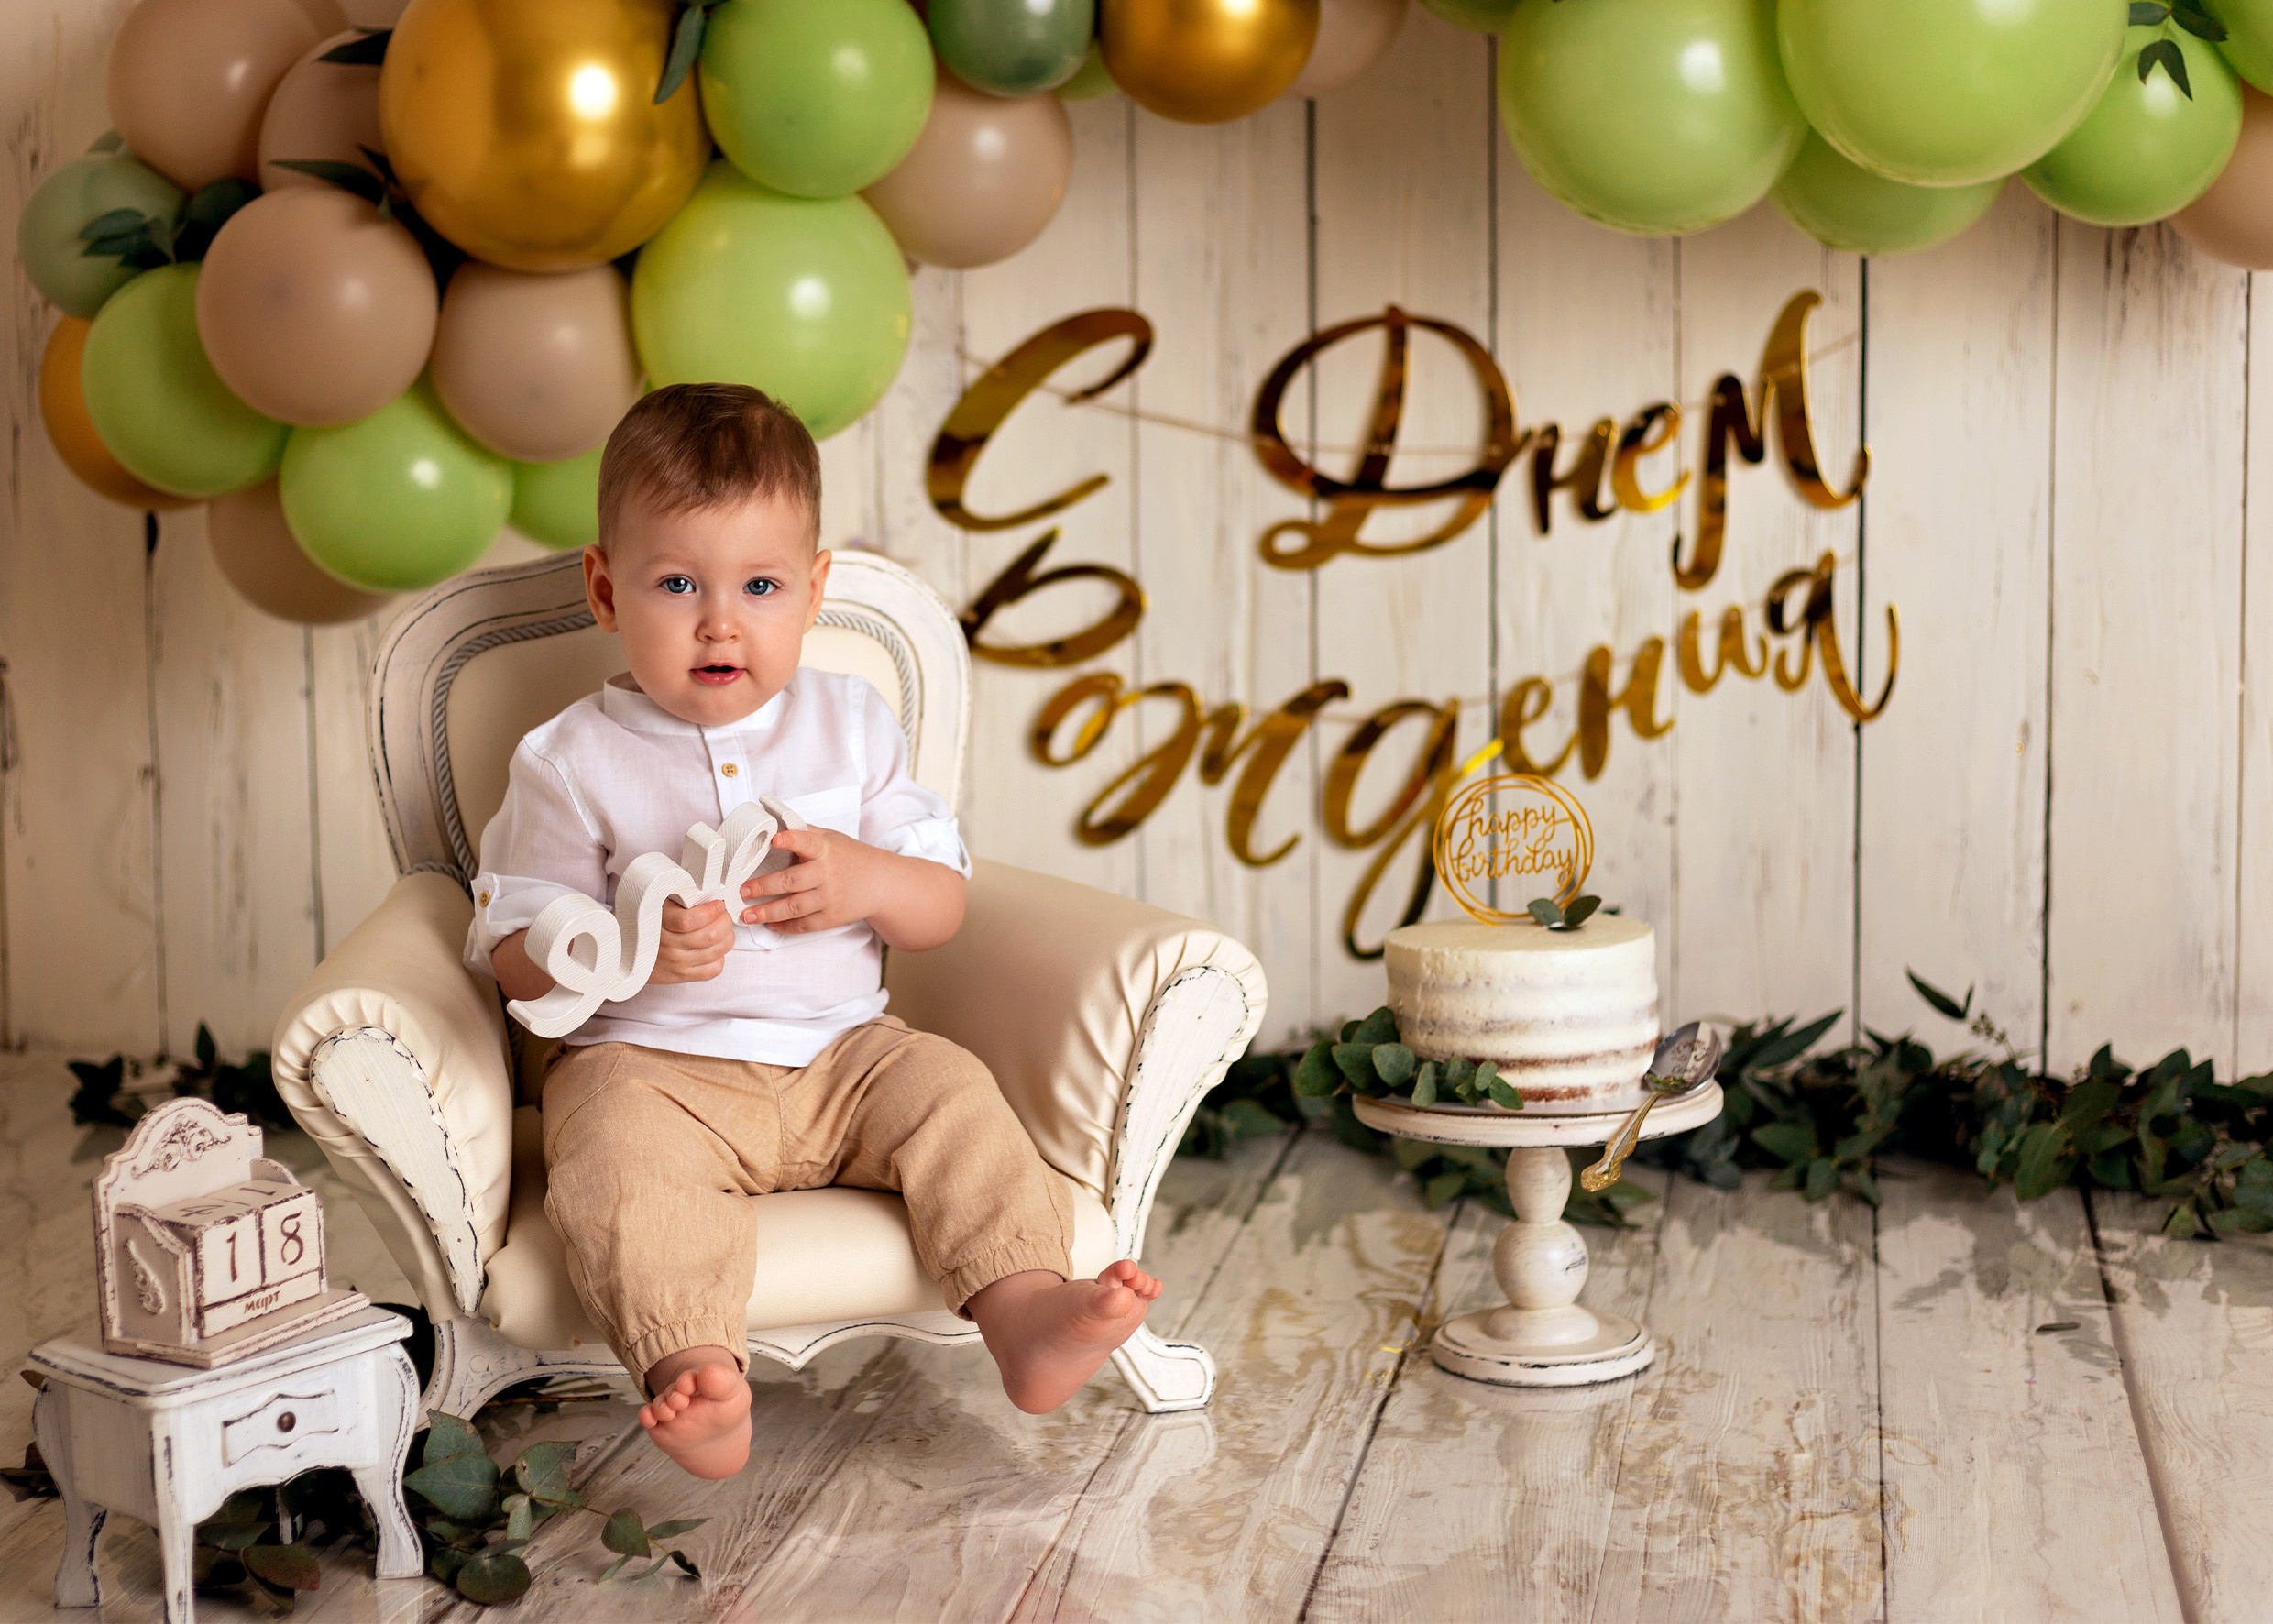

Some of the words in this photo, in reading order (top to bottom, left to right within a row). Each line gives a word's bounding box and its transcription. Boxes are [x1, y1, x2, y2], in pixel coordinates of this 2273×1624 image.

[1467, 797, 1557, 844] happy
[1455, 837, 1572, 887] birthday
[243, 1290, 280, 1314] март
